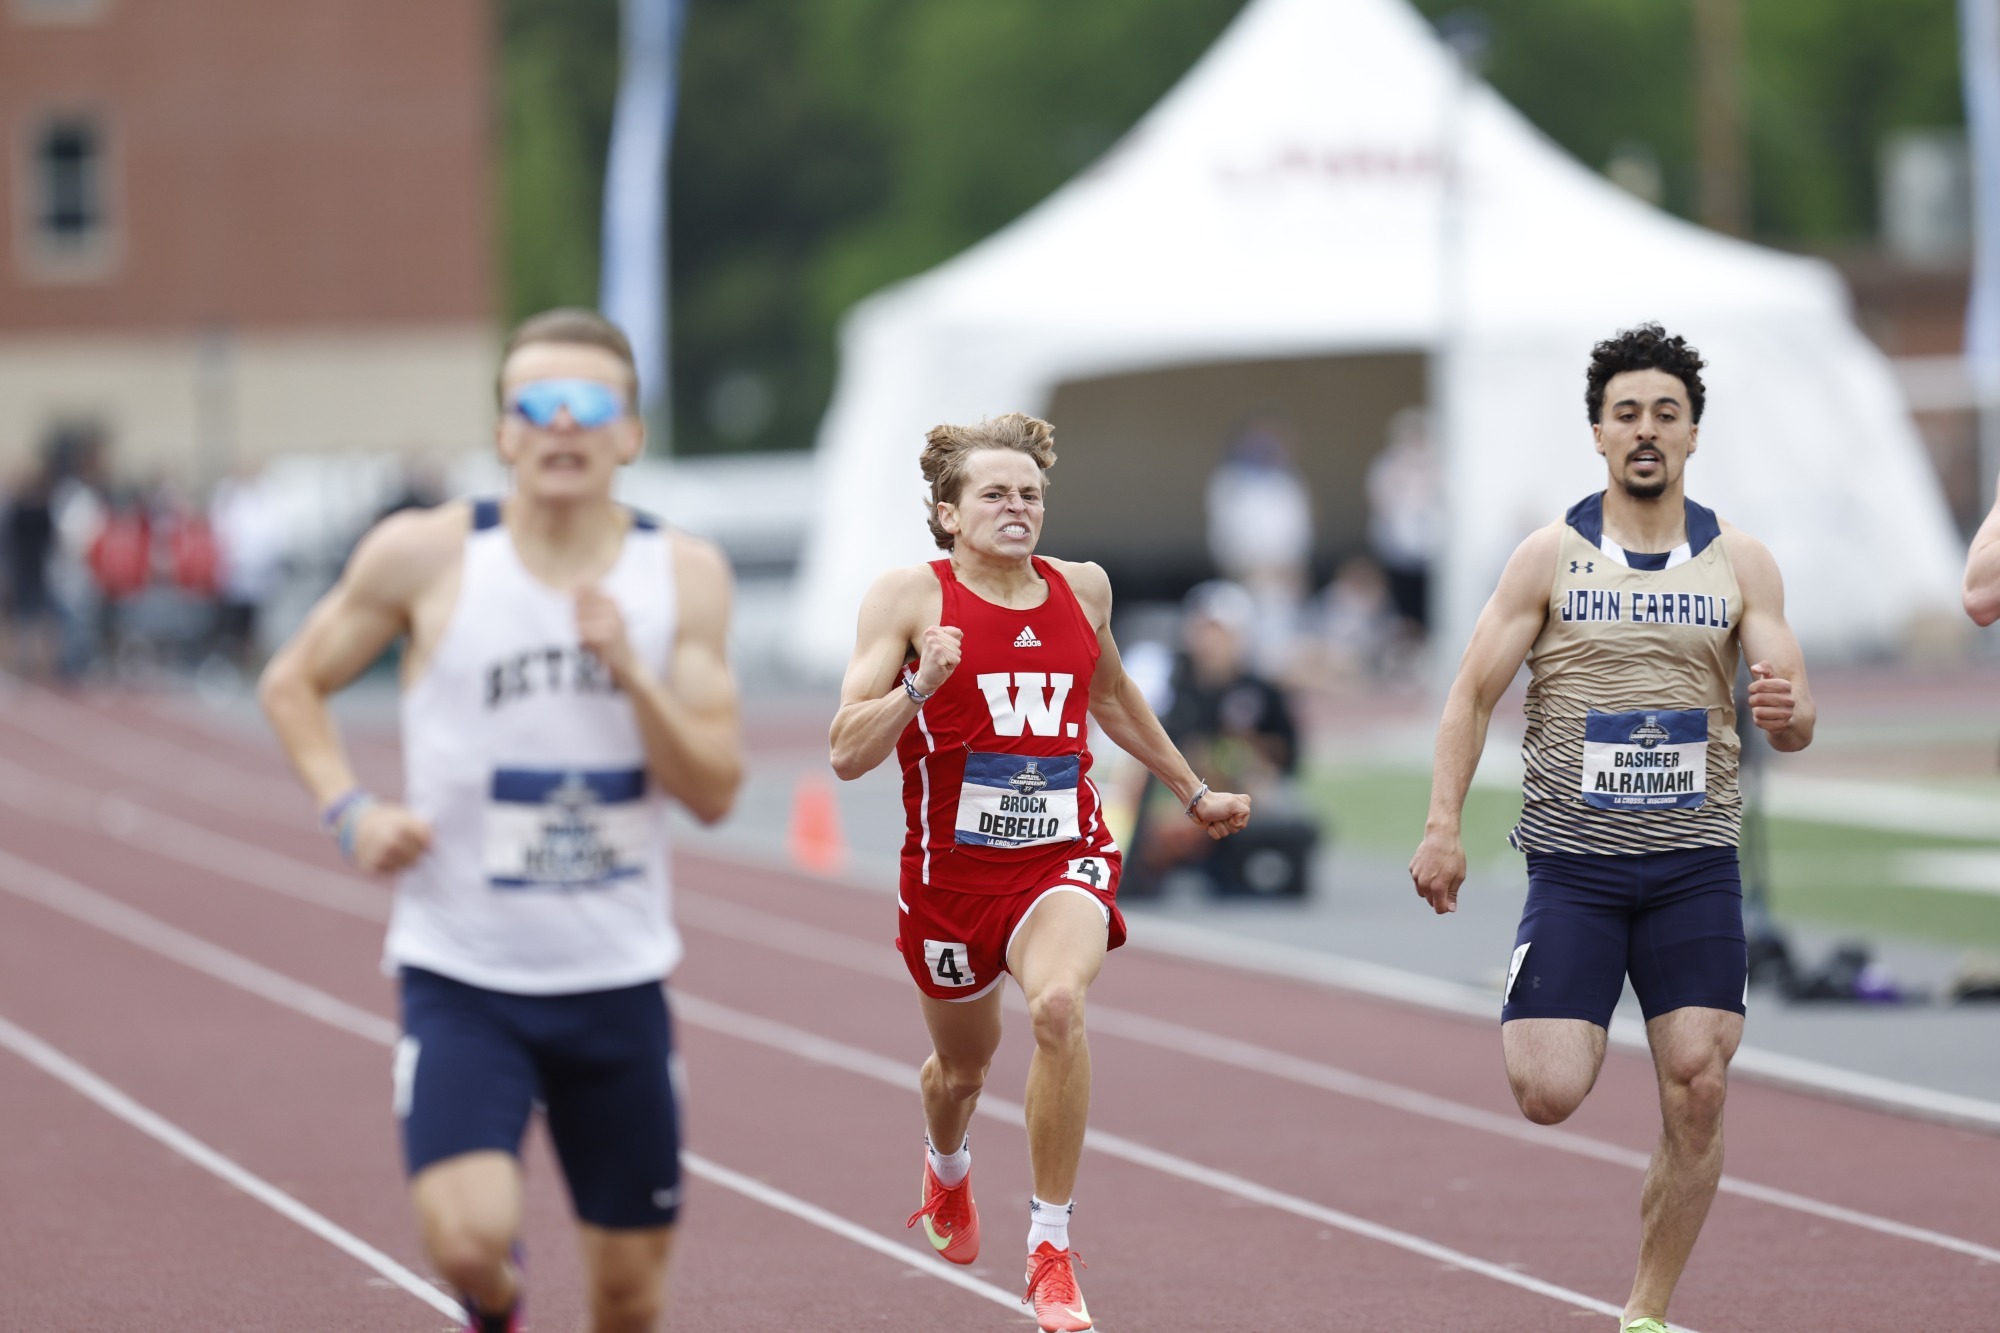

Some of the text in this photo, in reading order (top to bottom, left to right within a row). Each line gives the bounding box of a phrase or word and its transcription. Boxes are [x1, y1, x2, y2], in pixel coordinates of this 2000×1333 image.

[1562, 590, 1730, 629] JOHN CARROLL
[1013, 640, 1042, 648] adidas
[1614, 751, 1680, 768] BASHEER
[1594, 770, 1694, 794] ALRAMAHI
[999, 794, 1048, 813] BROCK
[978, 811, 1059, 839] DEBELLO
[1076, 858, 1102, 887] 4
[936, 948, 964, 985] 4
